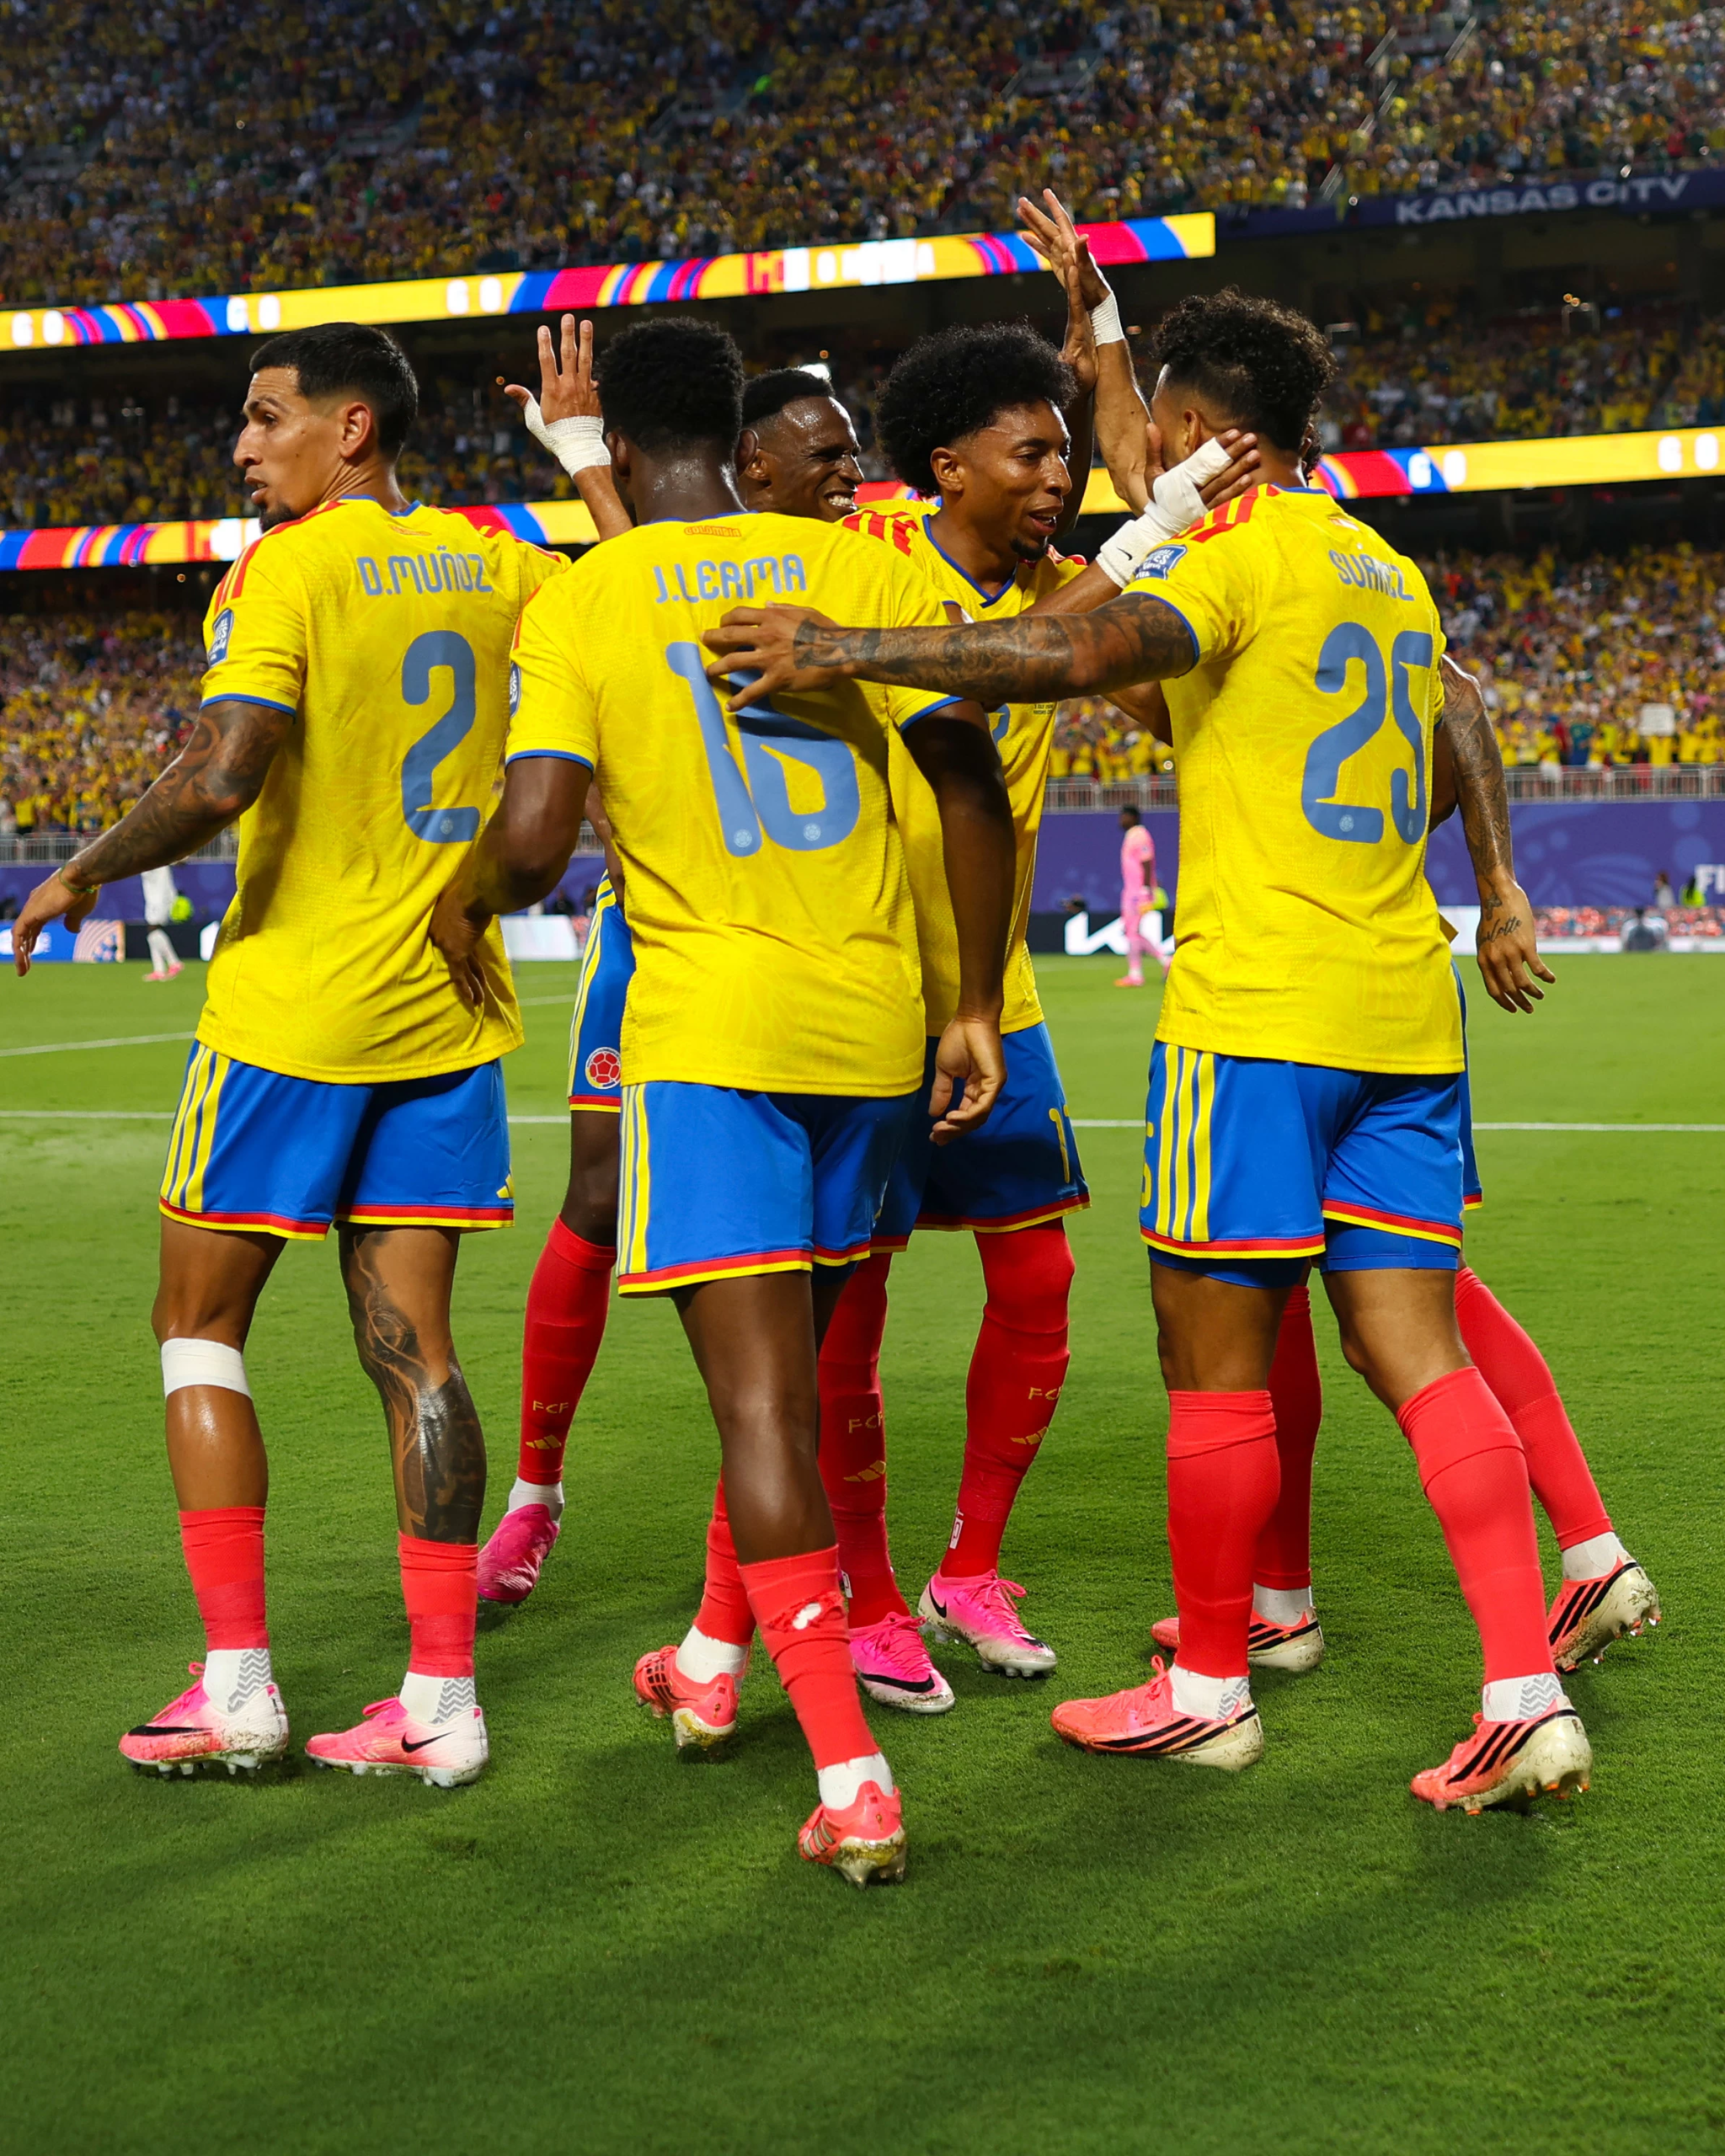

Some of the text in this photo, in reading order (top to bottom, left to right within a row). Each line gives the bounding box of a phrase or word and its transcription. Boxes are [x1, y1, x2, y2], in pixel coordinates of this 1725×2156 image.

[1395, 174, 1689, 224] KANSAS CITY
[652, 553, 807, 604] J.LERMA
[401, 629, 481, 844] 2
[665, 641, 861, 857] 16
[1301, 622, 1433, 845] 25
[532, 1400, 569, 1414] FCF
